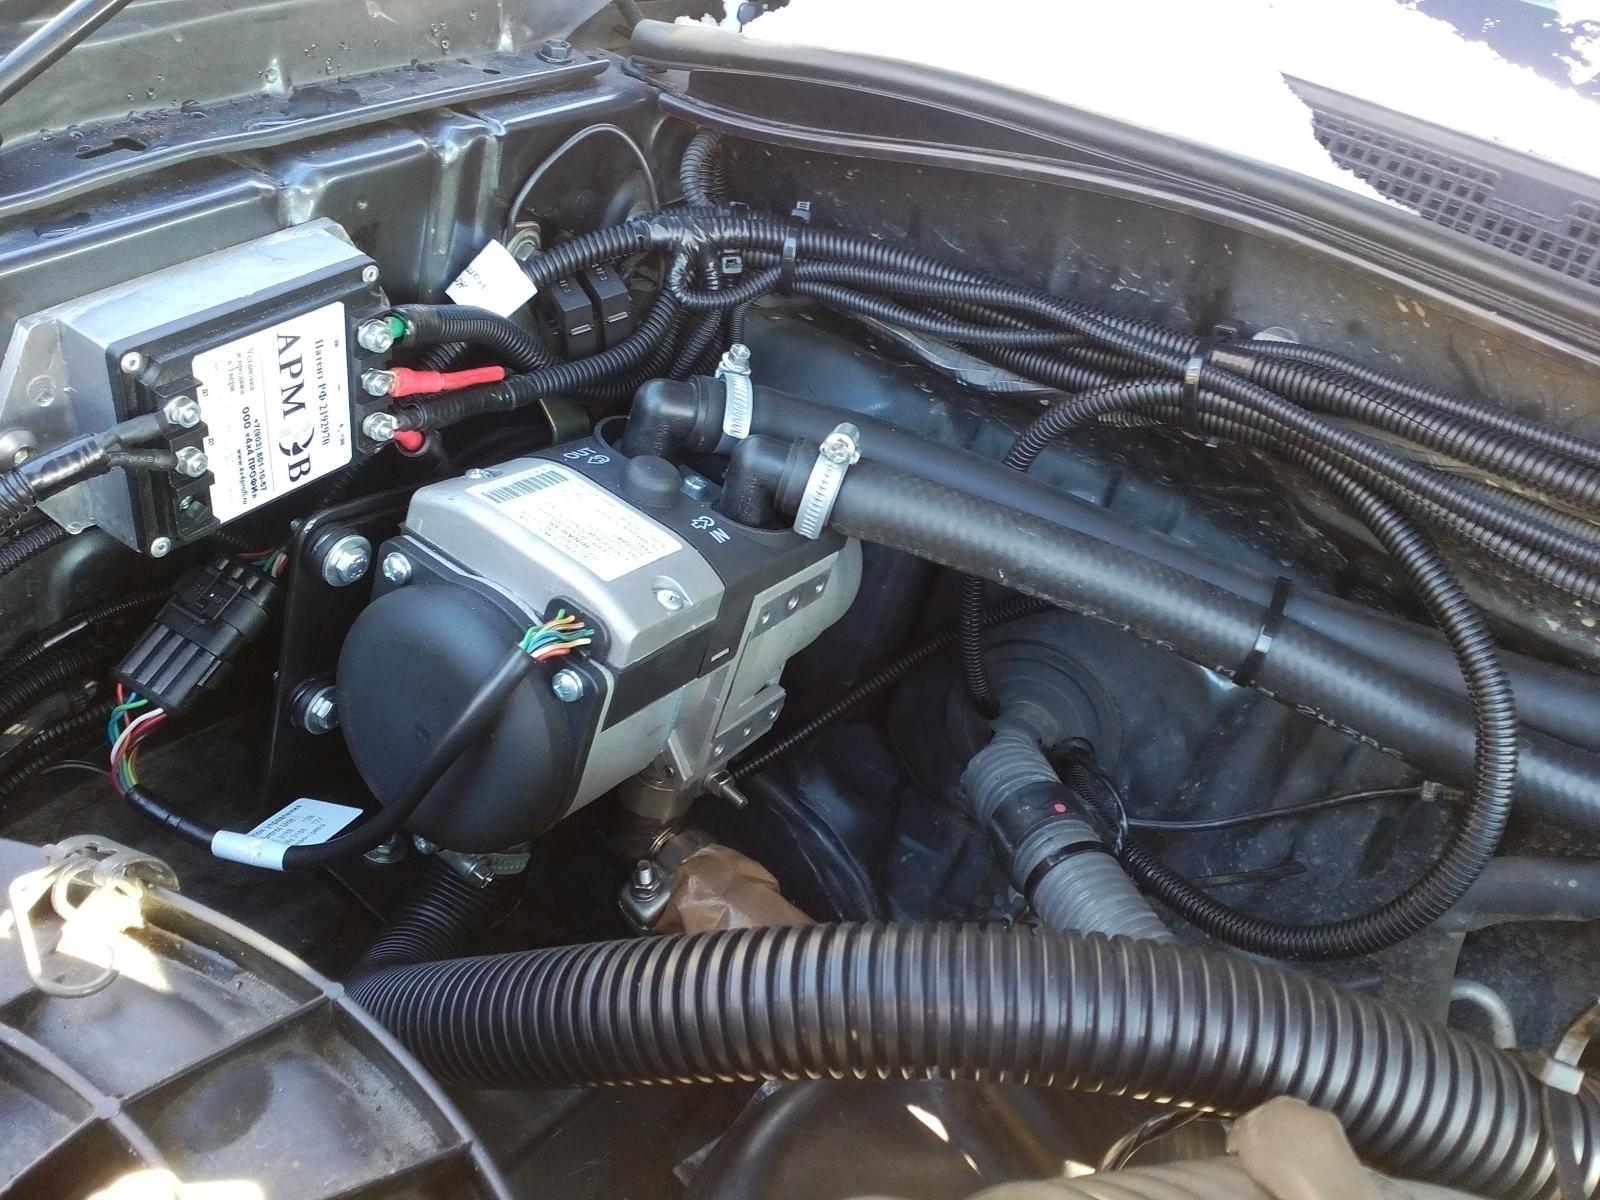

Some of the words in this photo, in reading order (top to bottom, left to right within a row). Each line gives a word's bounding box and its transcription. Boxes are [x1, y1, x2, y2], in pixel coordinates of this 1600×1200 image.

[315, 339, 325, 381] Патент
[318, 383, 327, 401] РФ
[320, 403, 331, 446] 2192970
[242, 406, 251, 429] ООО
[248, 457, 258, 499] ПРОФИ»
[563, 447, 597, 460] OUT
[709, 528, 731, 545] IN
